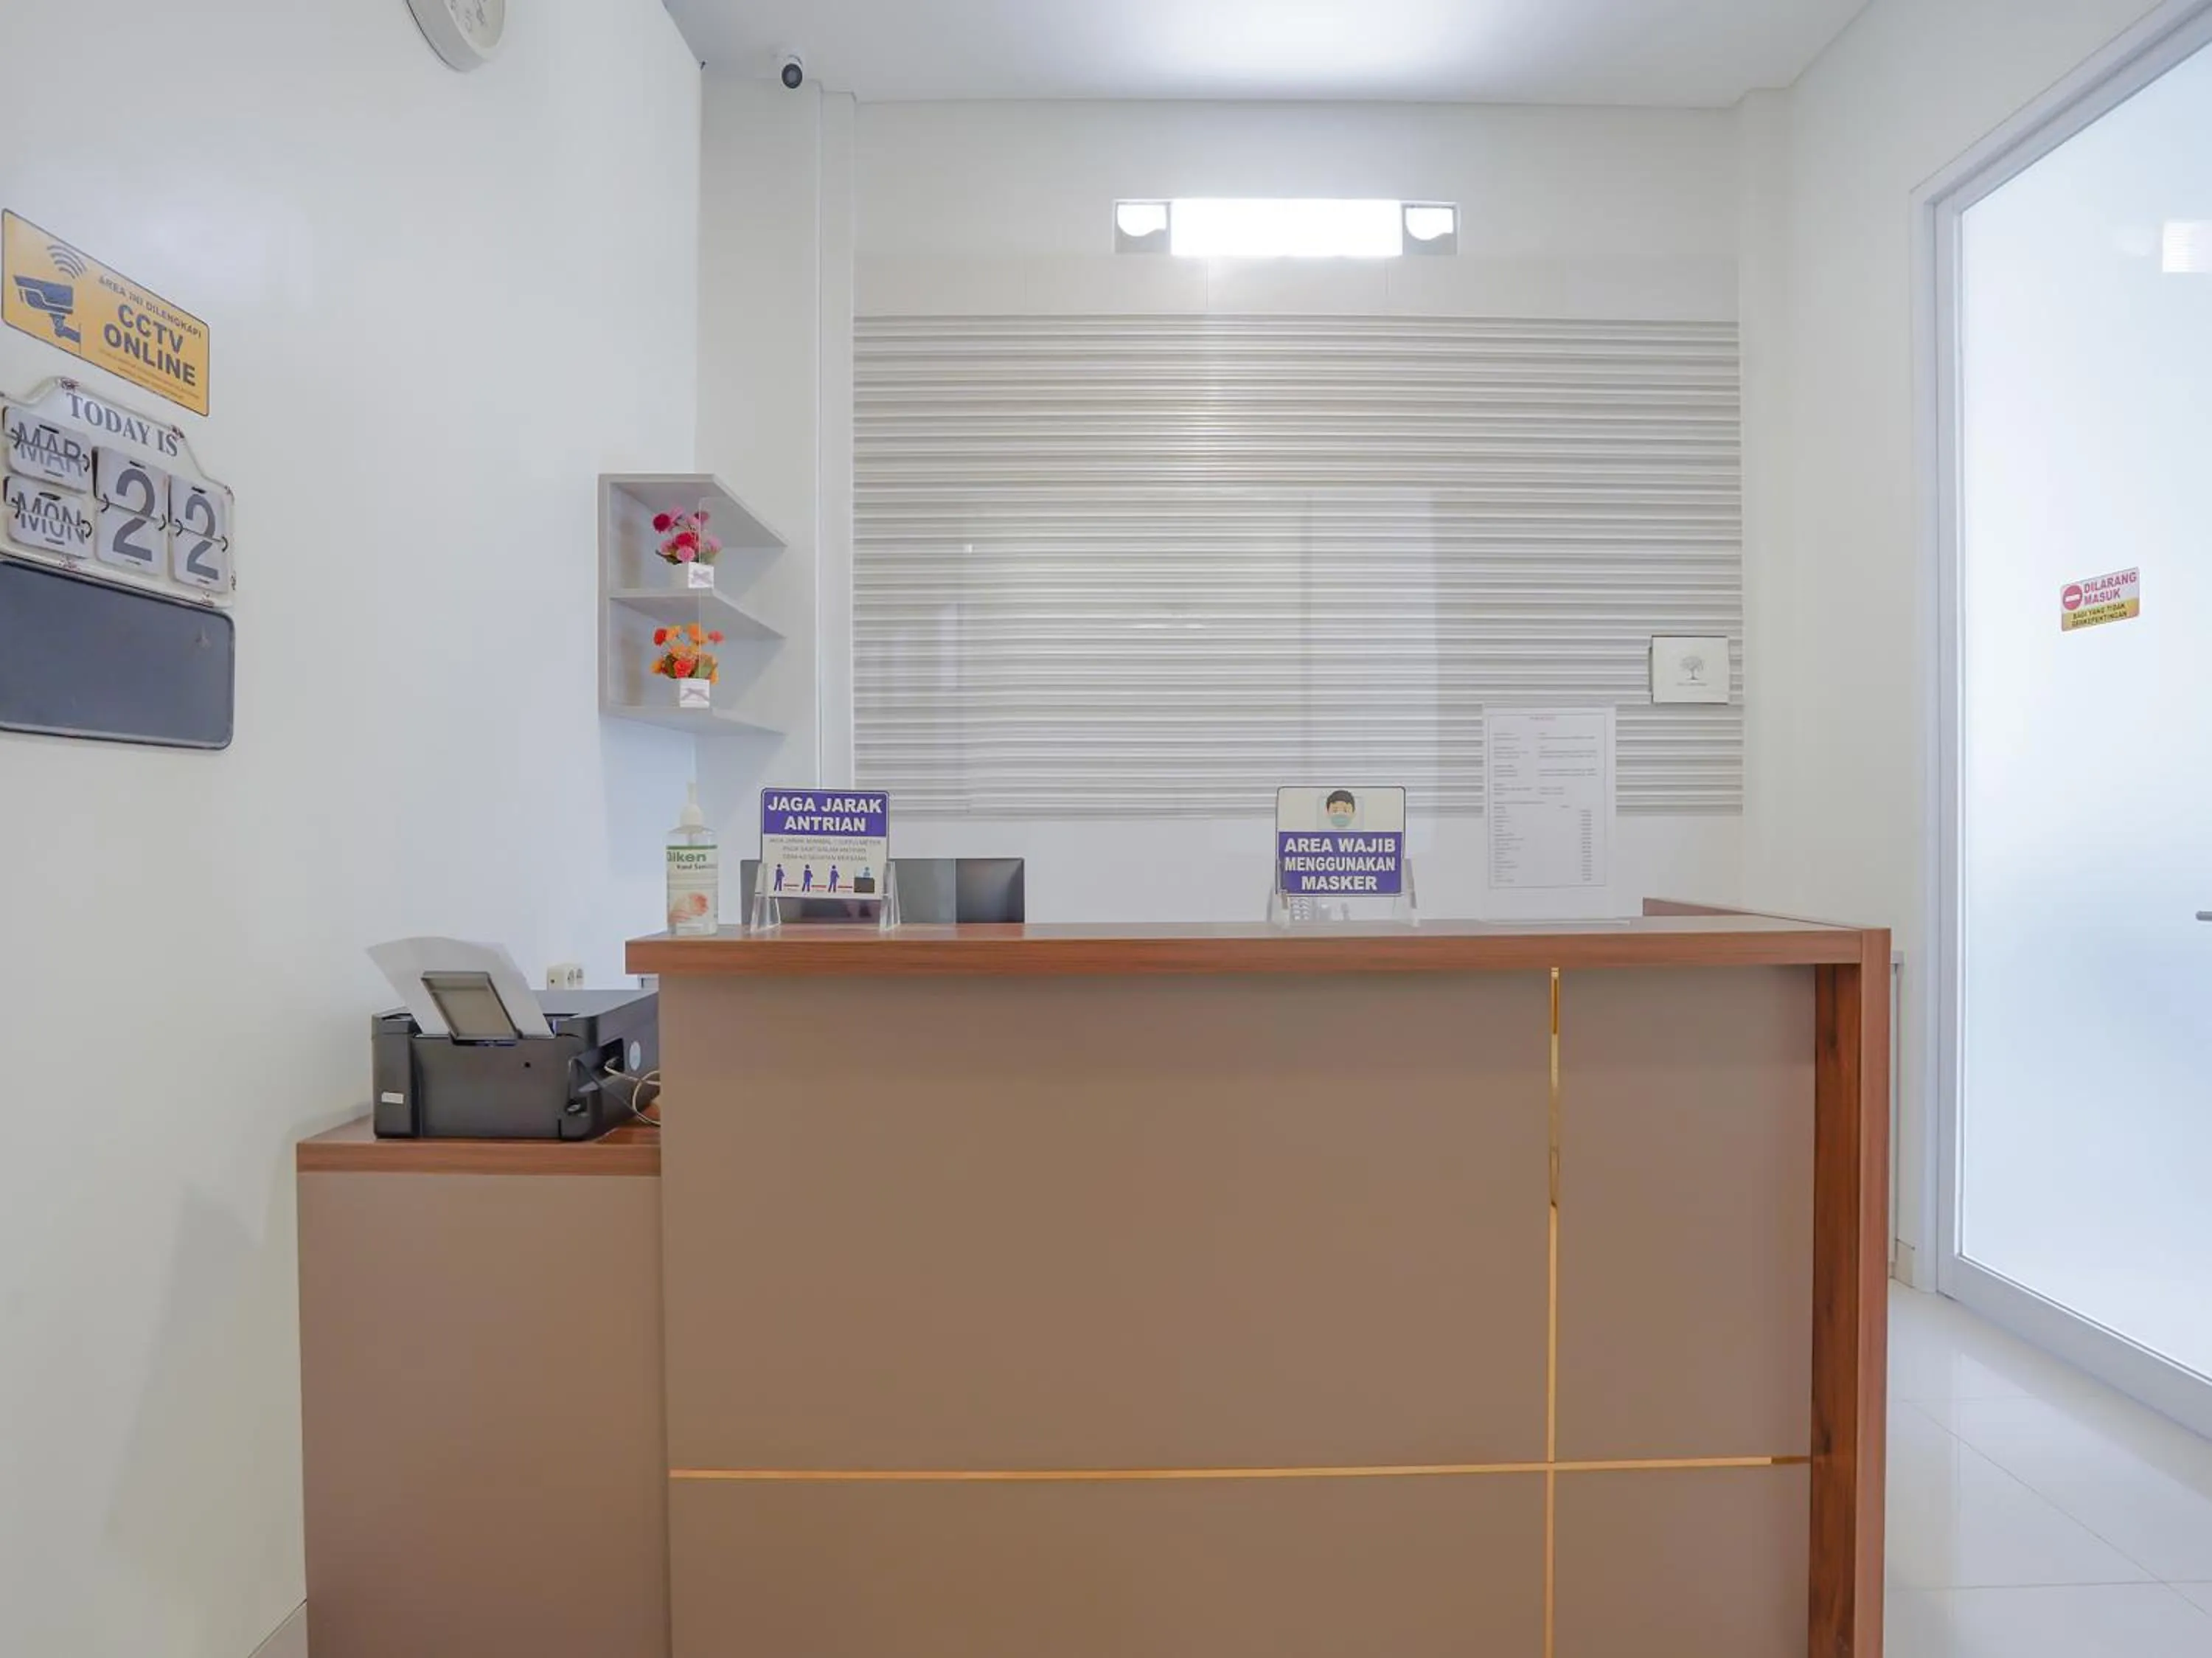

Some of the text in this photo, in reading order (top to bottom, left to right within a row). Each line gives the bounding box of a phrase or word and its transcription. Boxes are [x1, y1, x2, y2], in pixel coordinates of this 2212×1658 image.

[99, 274, 126, 296] AREA
[117, 304, 184, 355] CCTV
[103, 322, 196, 386] ONLINE
[66, 392, 179, 457] TODAY IS
[16, 420, 83, 477] MAR
[16, 491, 86, 544] MON
[2084, 572, 2136, 594] DILARANG
[2084, 588, 2121, 605] MASUK
[768, 796, 883, 814] JAGA JARAK
[784, 816, 866, 832] ANTRIAN
[1284, 837, 1396, 853] AREA WAJIB
[1284, 856, 1396, 871] MENGGUNAKAN
[1301, 875, 1377, 890] MASKER
